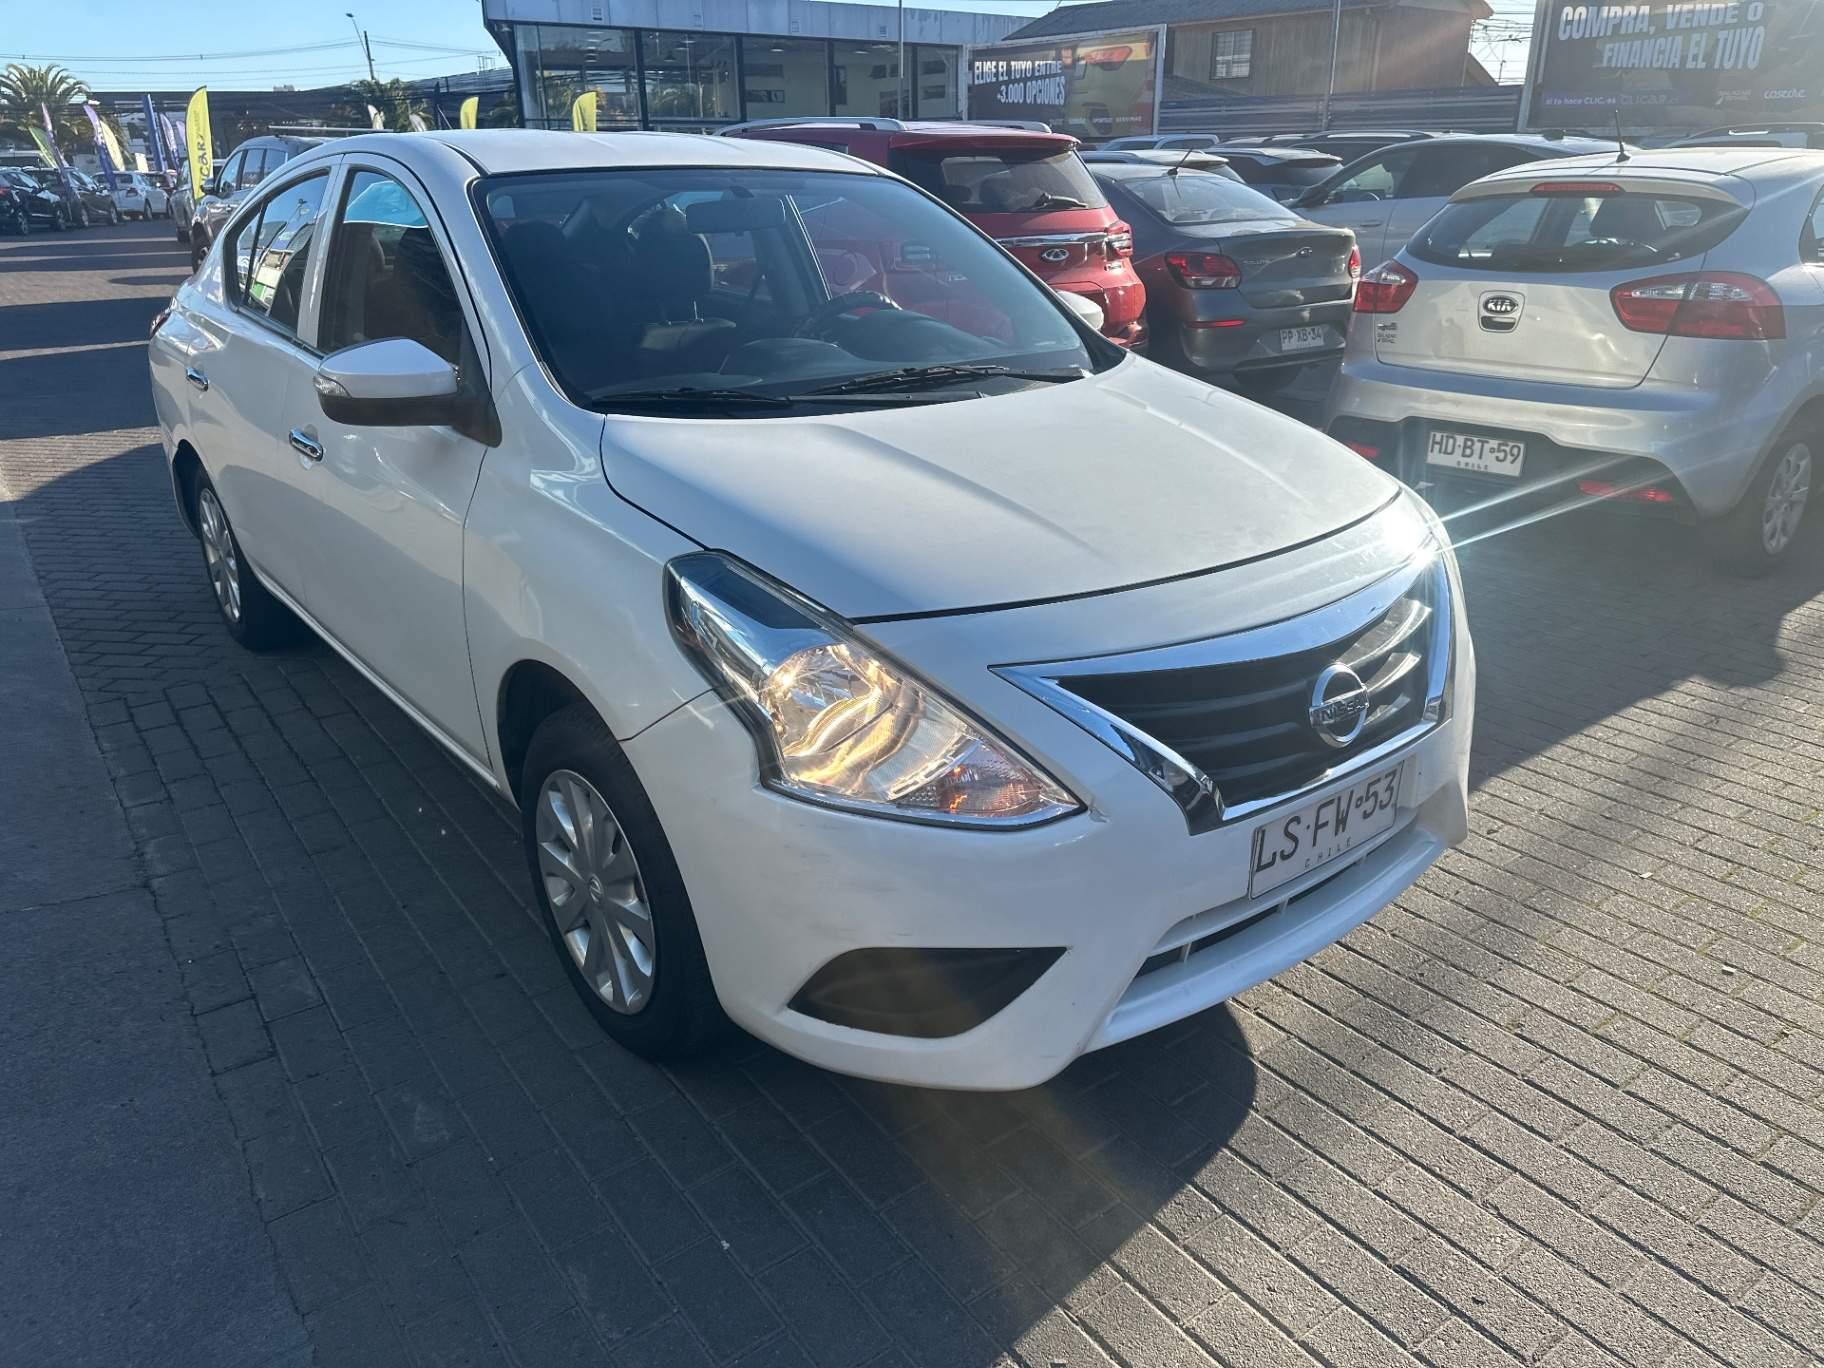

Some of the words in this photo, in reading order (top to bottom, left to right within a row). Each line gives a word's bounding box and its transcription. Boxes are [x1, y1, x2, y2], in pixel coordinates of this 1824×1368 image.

[1558, 5, 1655, 40] COMPRA,
[1665, 2, 1740, 30] VENDE
[1602, 35, 1683, 68] FINANCIA
[1686, 32, 1708, 69] EL
[1714, 25, 1765, 71] TUYO
[974, 60, 997, 84] ELIGE
[999, 60, 1009, 81] EL
[1010, 60, 1033, 80] TUYO
[1034, 60, 1062, 76] ENTRE
[1026, 76, 1065, 105] OPCIONES
[1304, 836, 1352, 869] CHILE
